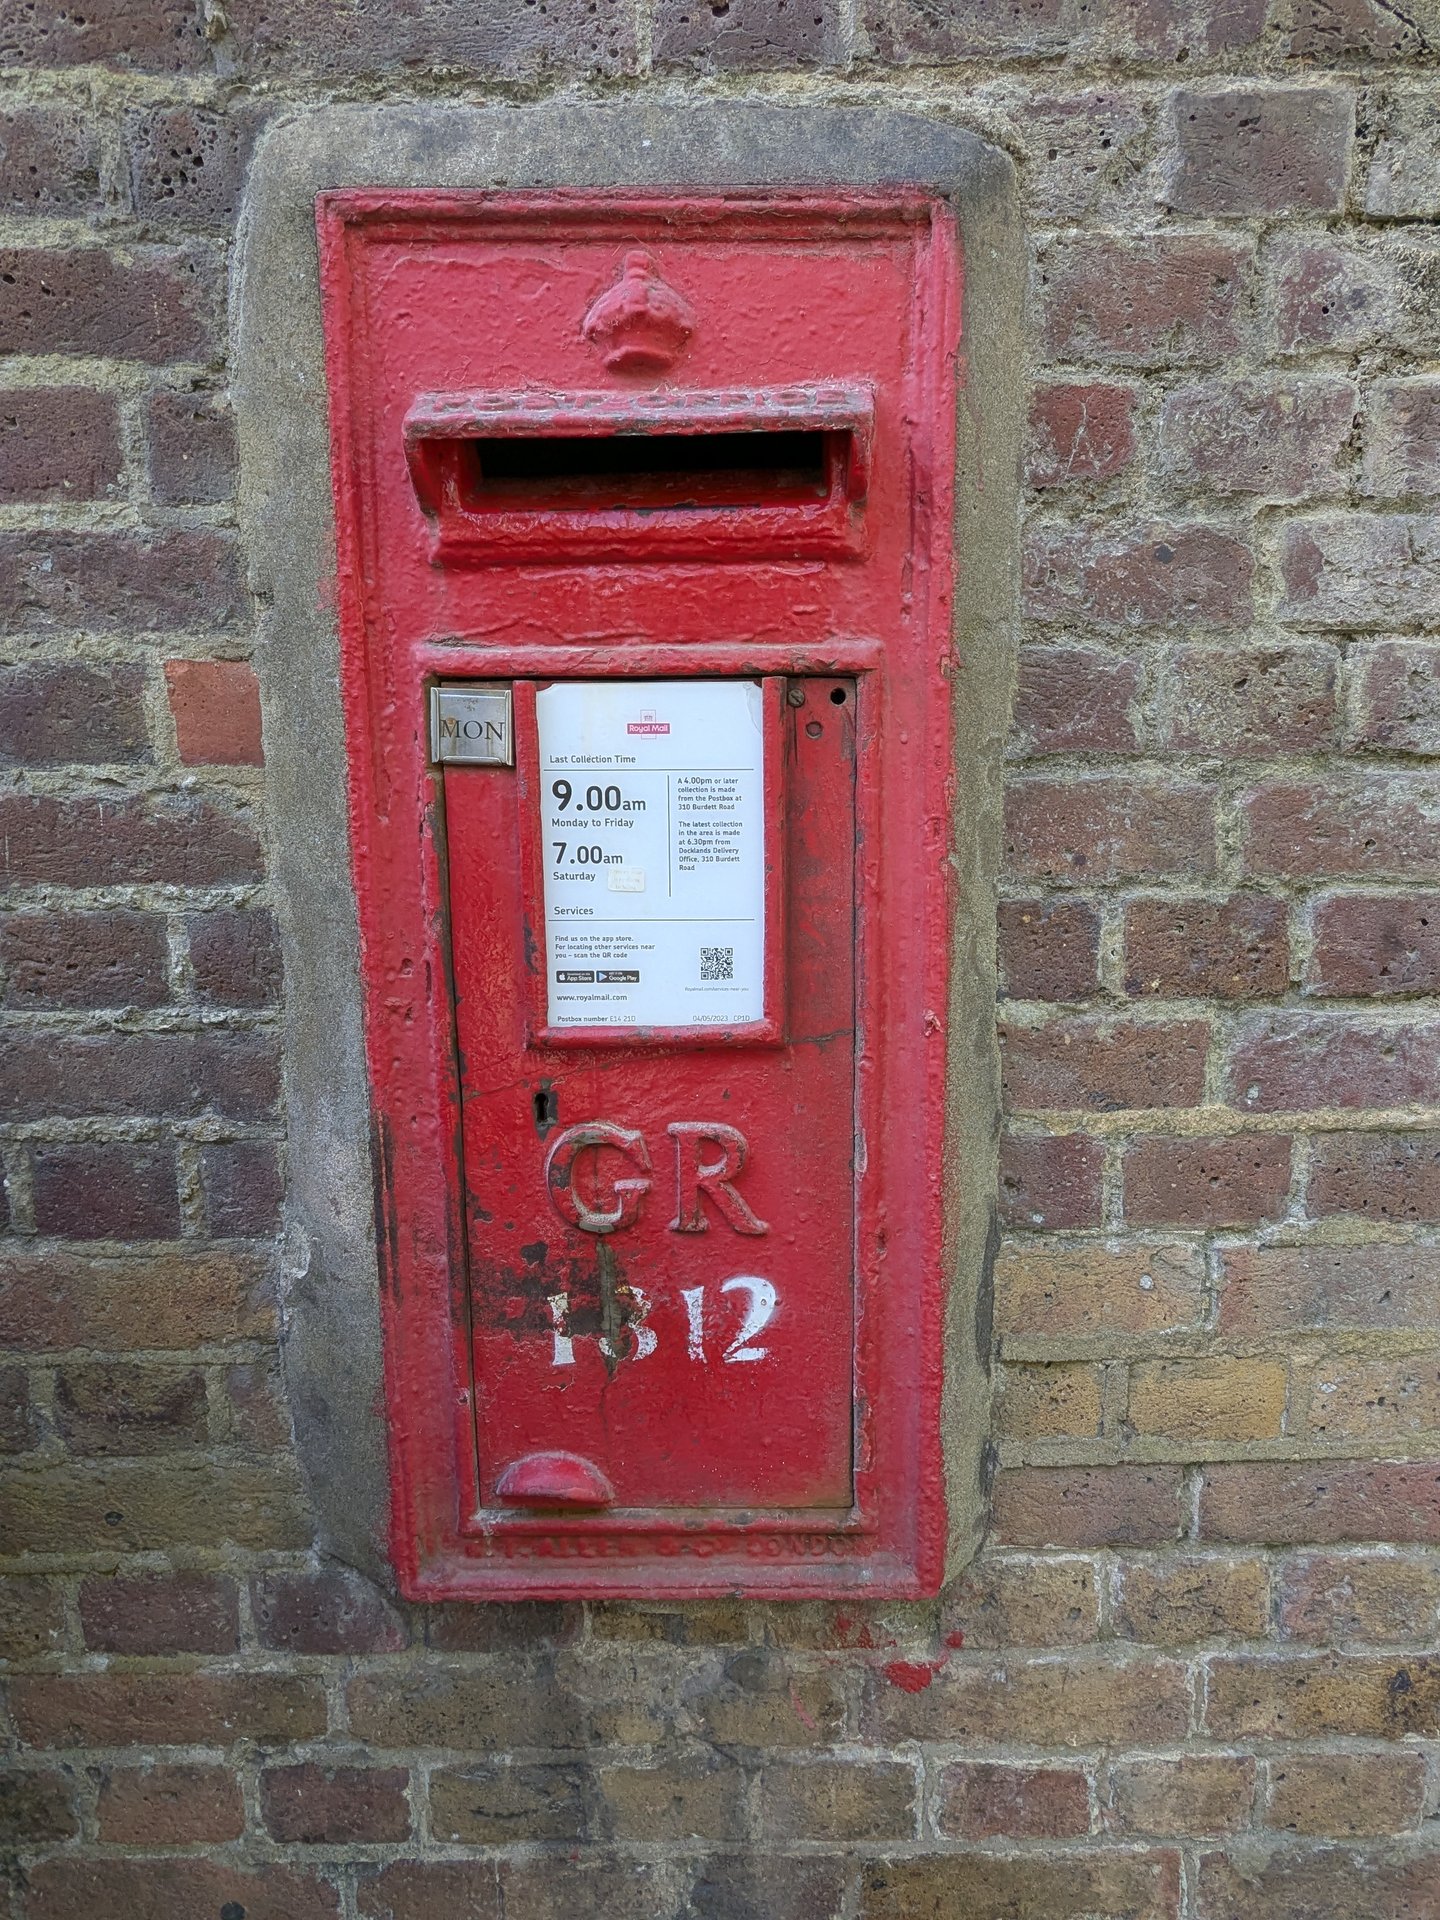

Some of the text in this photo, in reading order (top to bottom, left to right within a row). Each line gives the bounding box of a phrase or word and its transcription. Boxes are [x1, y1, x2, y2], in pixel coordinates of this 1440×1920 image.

[440, 719, 506, 741] MON
[629, 724, 651, 733] Royal
[549, 755, 636, 763] Last Collection Time
[684, 777, 712, 785] 4.00pm
[552, 779, 646, 811] 9.00am
[551, 818, 634, 829] Monday to Friday
[552, 842, 623, 864] 7.00am
[553, 872, 596, 882] Saturday
[554, 906, 594, 915] Services
[556, 994, 628, 1002] www.royalmail.com
[545, 1119, 770, 1235] GR
